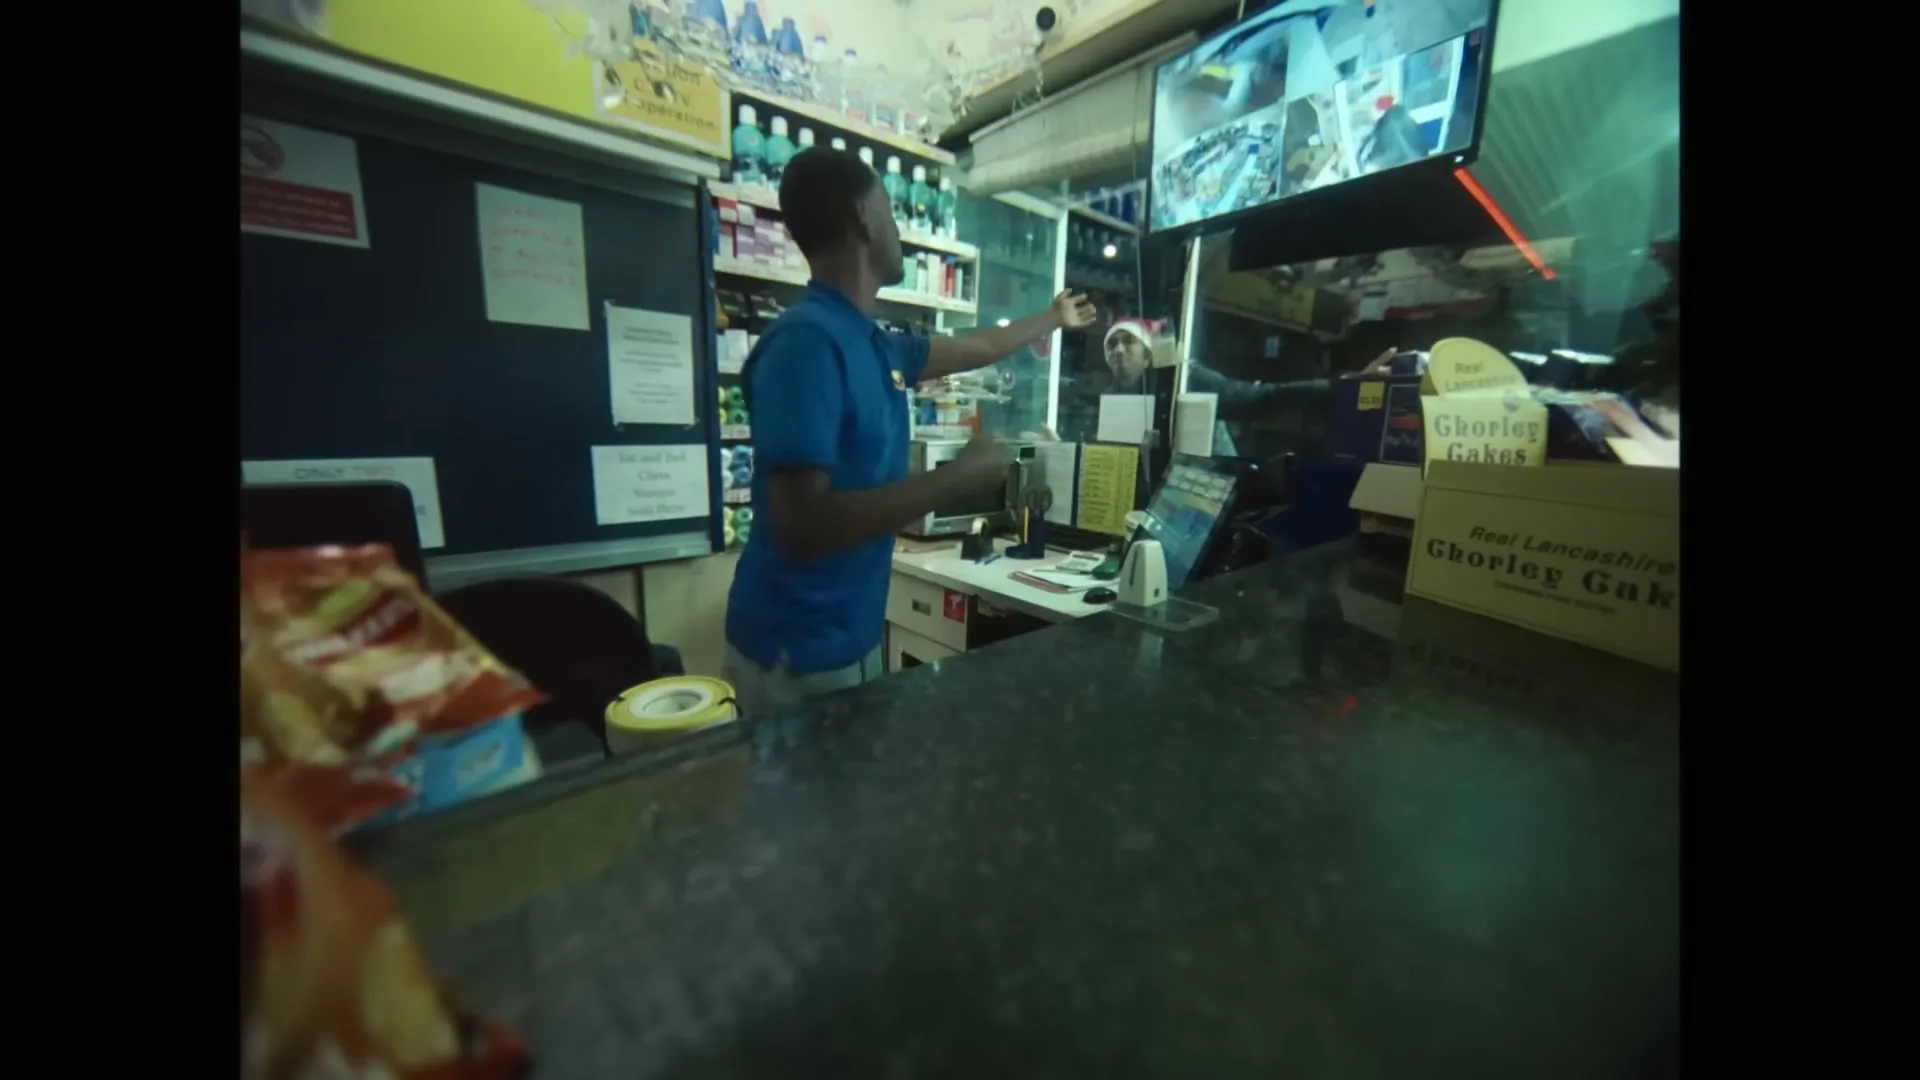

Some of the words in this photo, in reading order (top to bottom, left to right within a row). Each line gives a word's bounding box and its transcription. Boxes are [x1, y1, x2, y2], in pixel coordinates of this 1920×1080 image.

[1455, 362, 1485, 375] Real
[1444, 373, 1518, 391] Lancashire
[1433, 413, 1540, 442] Chorley
[294, 467, 345, 479] ONLY
[1469, 525, 1518, 546] Real
[1522, 535, 1677, 576] Lancashire
[1426, 538, 1563, 590] Chorley
